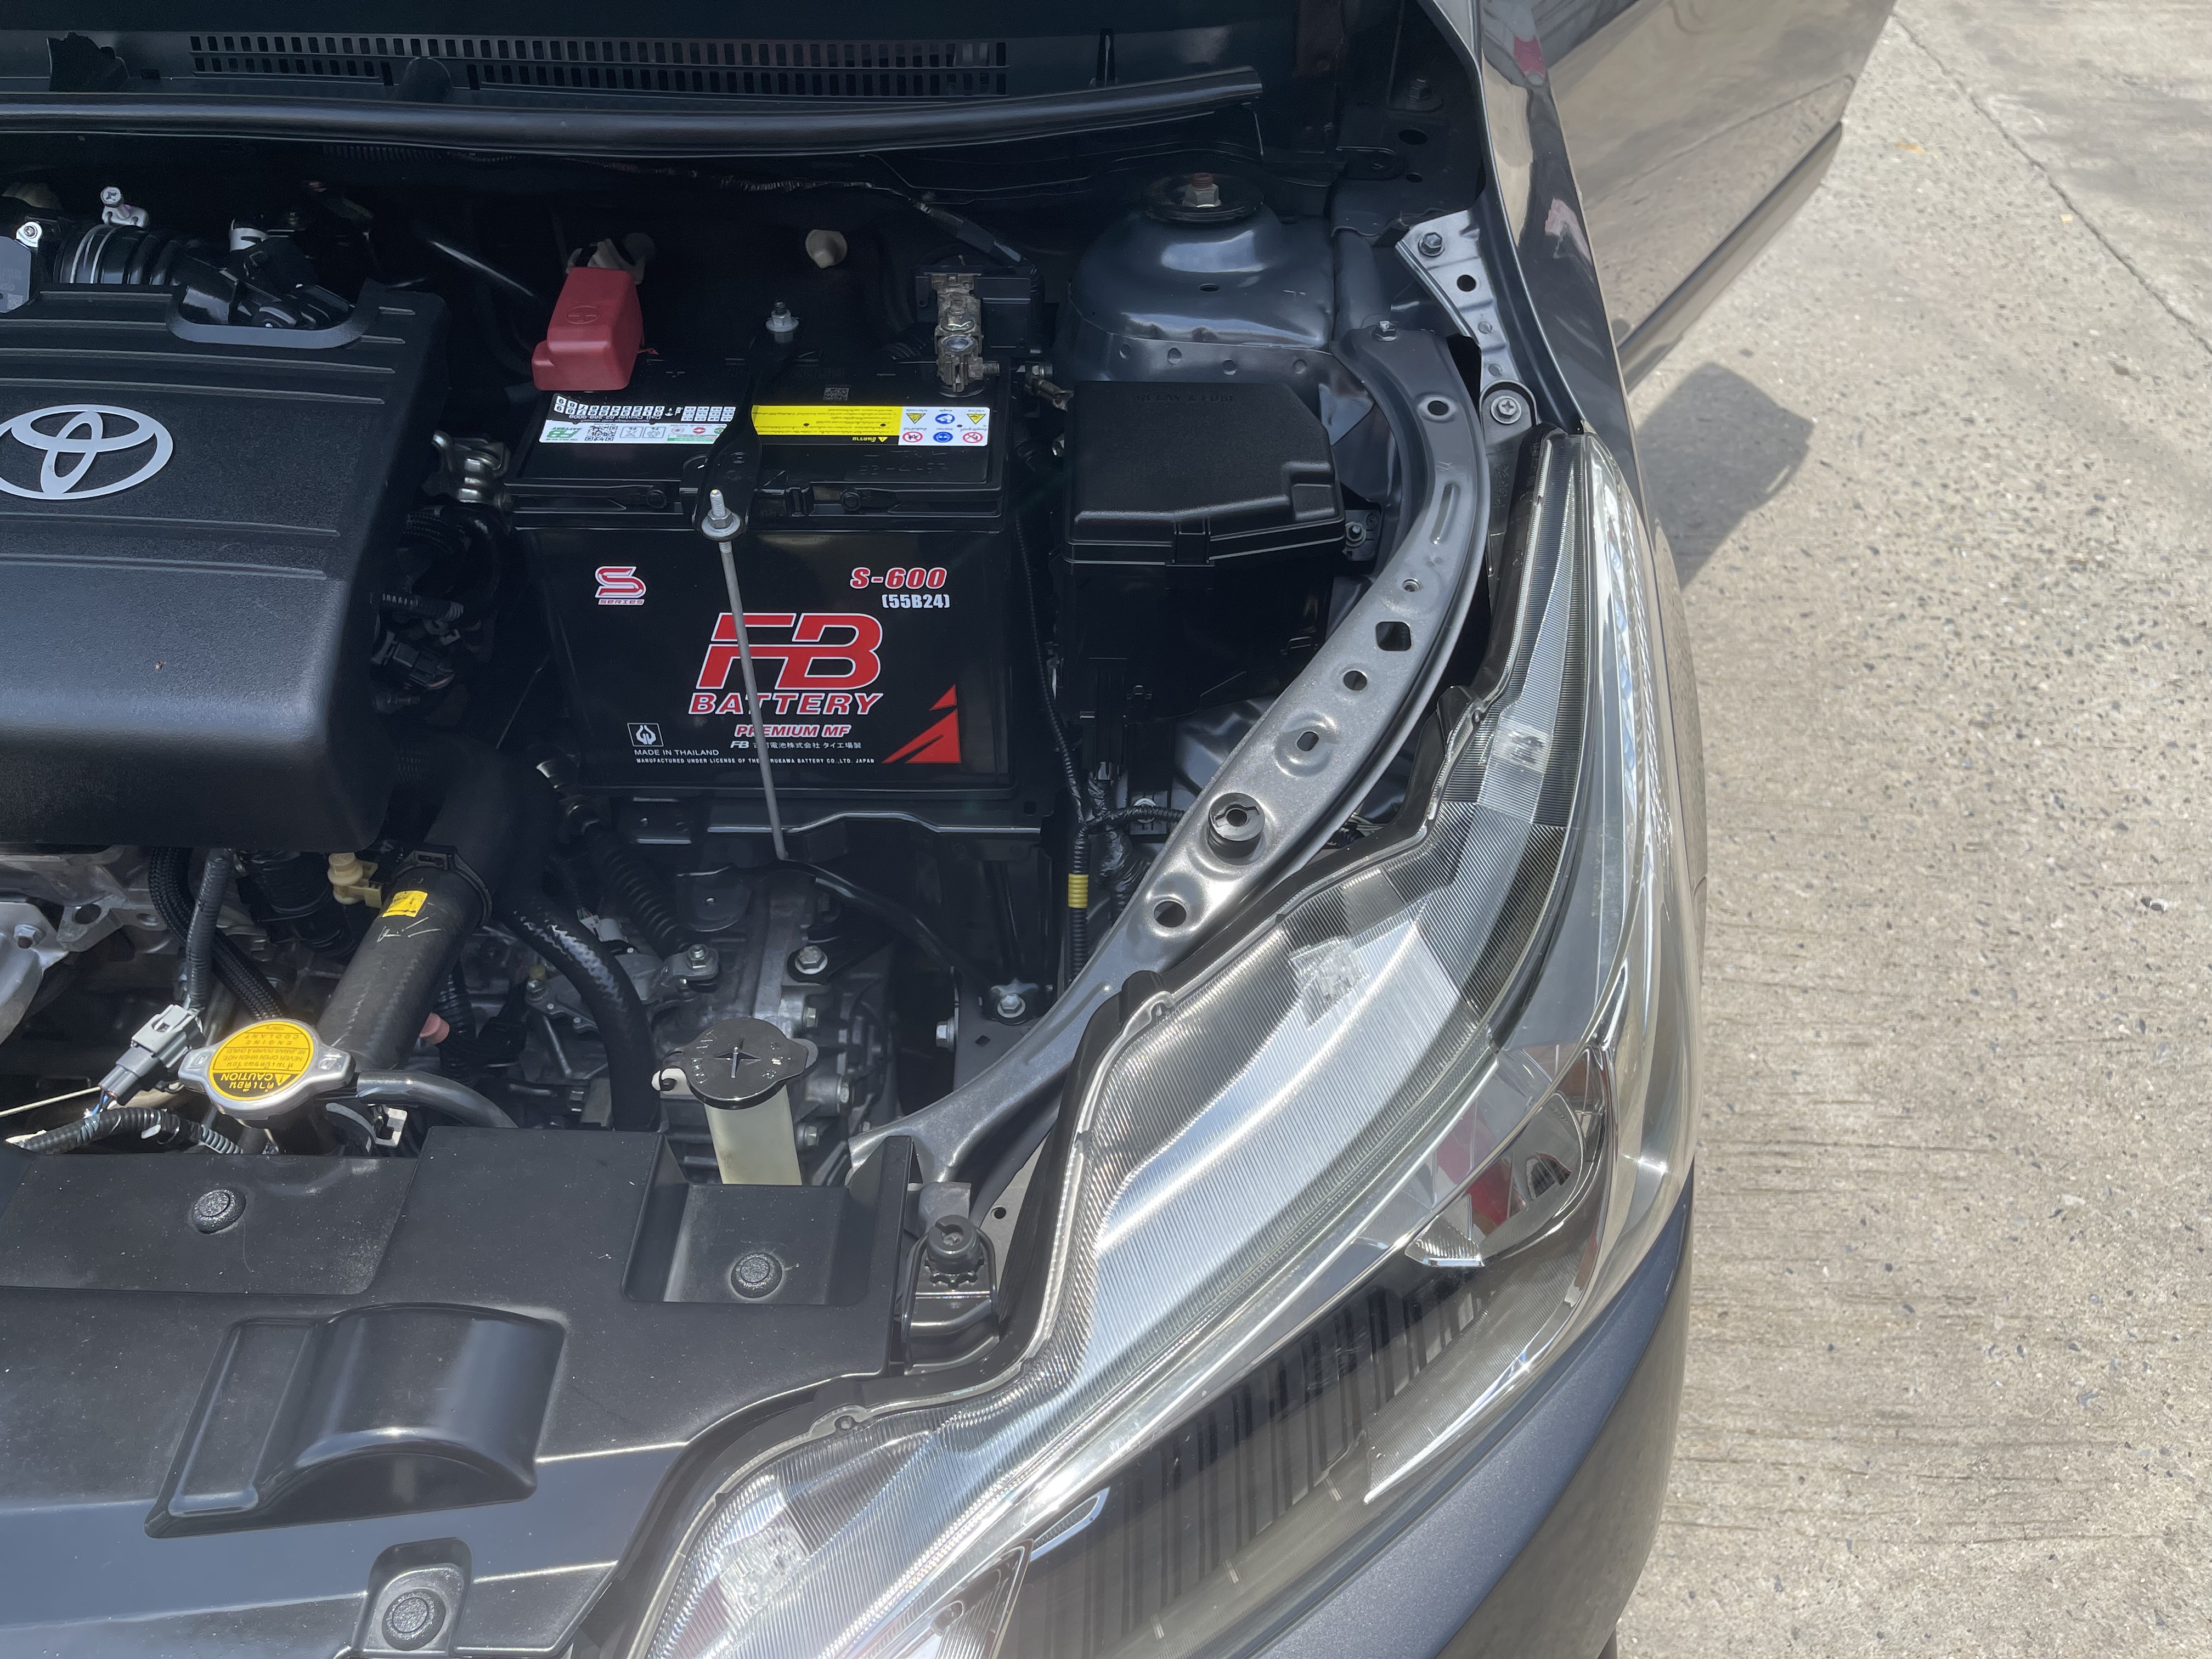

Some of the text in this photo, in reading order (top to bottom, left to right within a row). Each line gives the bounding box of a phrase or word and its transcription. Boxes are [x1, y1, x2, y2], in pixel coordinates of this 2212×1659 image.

[546, 430, 579, 438] FB
[595, 566, 646, 598] S
[850, 567, 947, 589] S-600
[882, 594, 950, 608] (55B24)
[696, 613, 883, 690] FB
[821, 724, 851, 737] MF
[730, 741, 749, 749] FB
[221, 1073, 273, 1081] CAUTION
